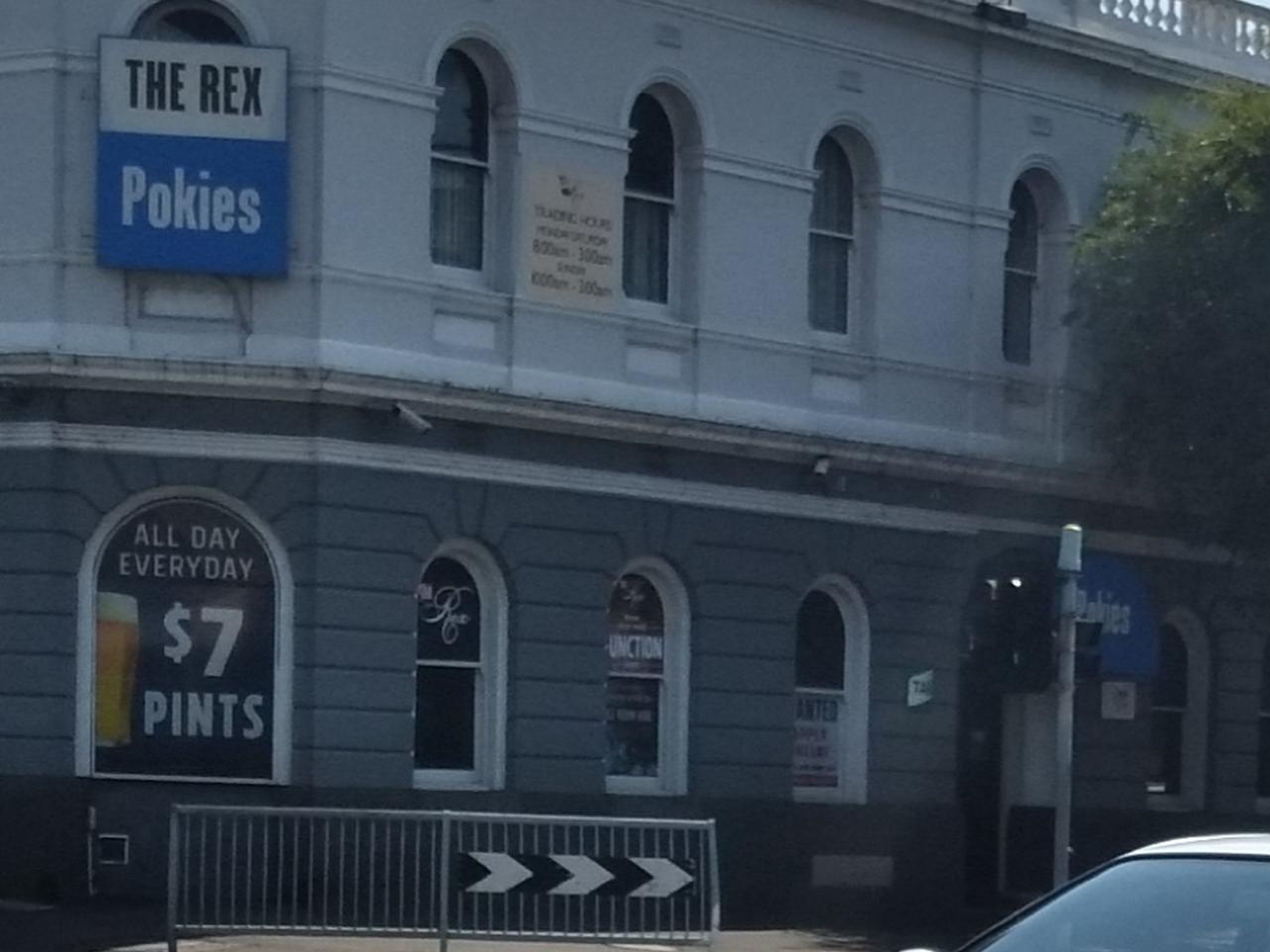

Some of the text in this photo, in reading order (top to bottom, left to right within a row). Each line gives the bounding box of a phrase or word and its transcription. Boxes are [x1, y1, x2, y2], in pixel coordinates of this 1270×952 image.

[125, 59, 263, 117] THE REX
[122, 165, 262, 234] Pokies
[134, 523, 240, 549] ALL DAY
[119, 552, 254, 580] EVERYDAY
[163, 602, 244, 677] $7
[608, 634, 662, 659] UNCTION
[144, 690, 264, 740] PINTS
